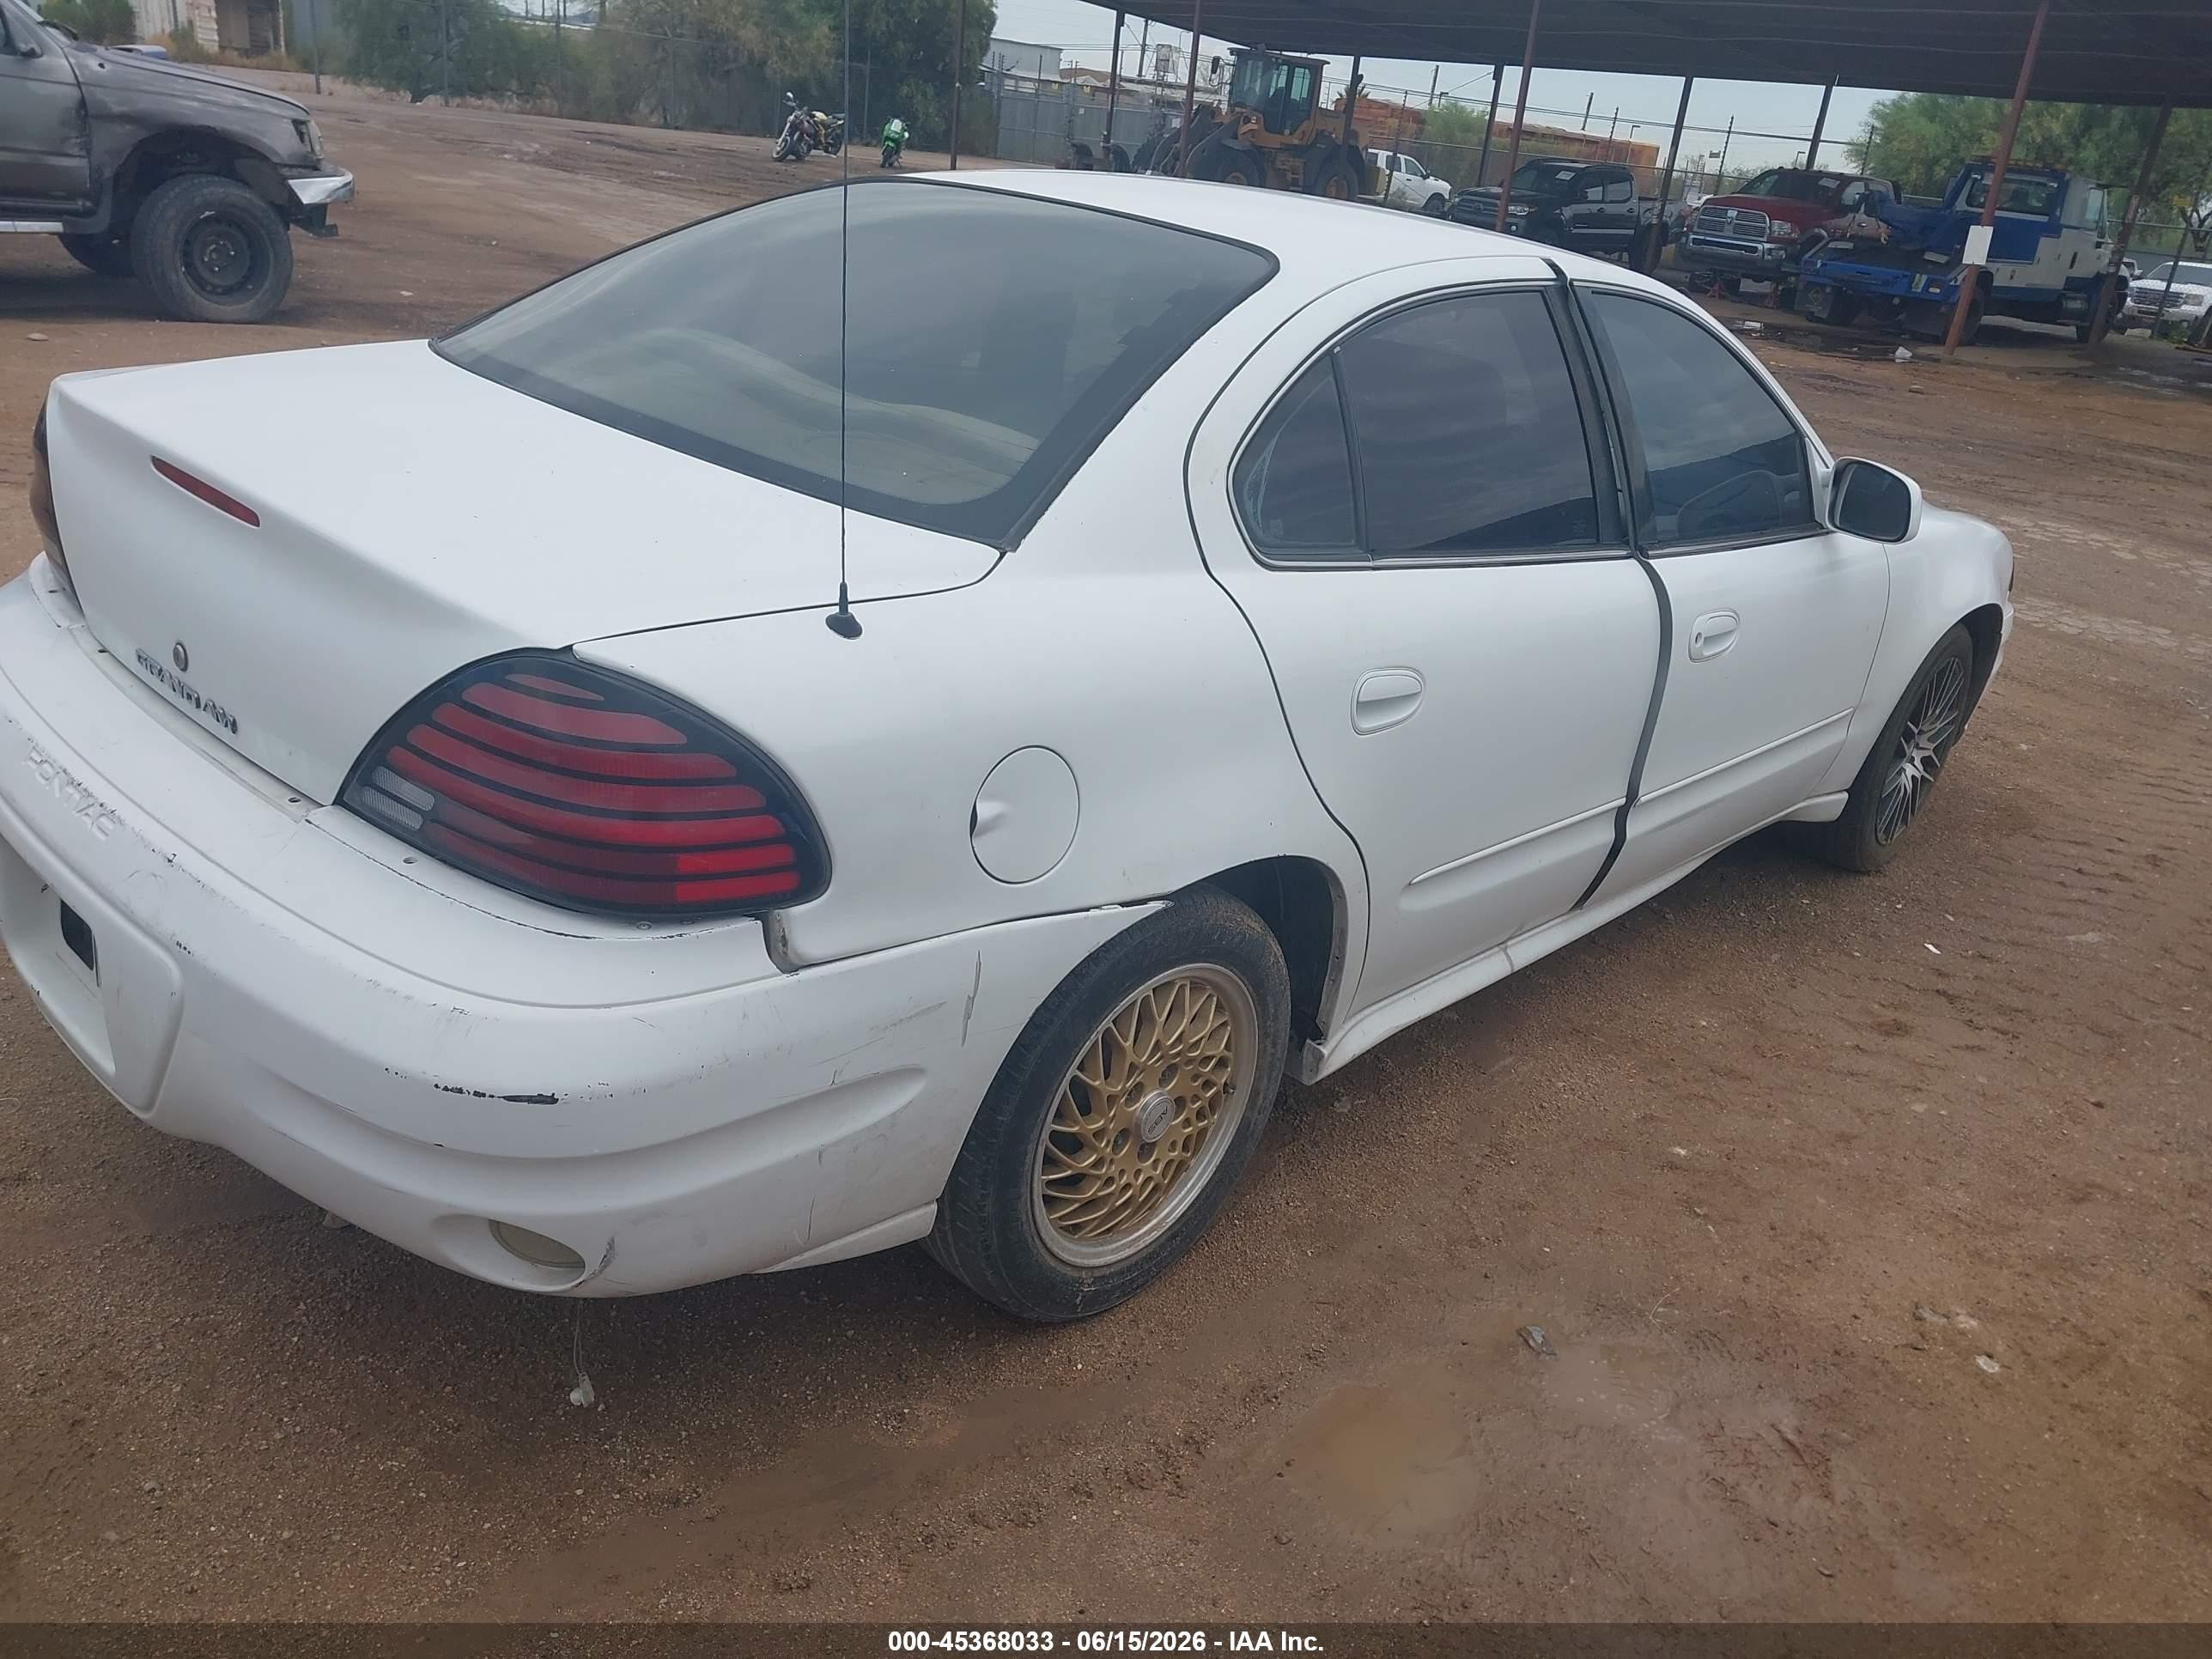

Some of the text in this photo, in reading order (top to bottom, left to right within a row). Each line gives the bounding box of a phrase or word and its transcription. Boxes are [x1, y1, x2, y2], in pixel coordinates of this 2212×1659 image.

[136, 647, 238, 734] GRAND AM
[26, 744, 118, 841] PONTIAC
